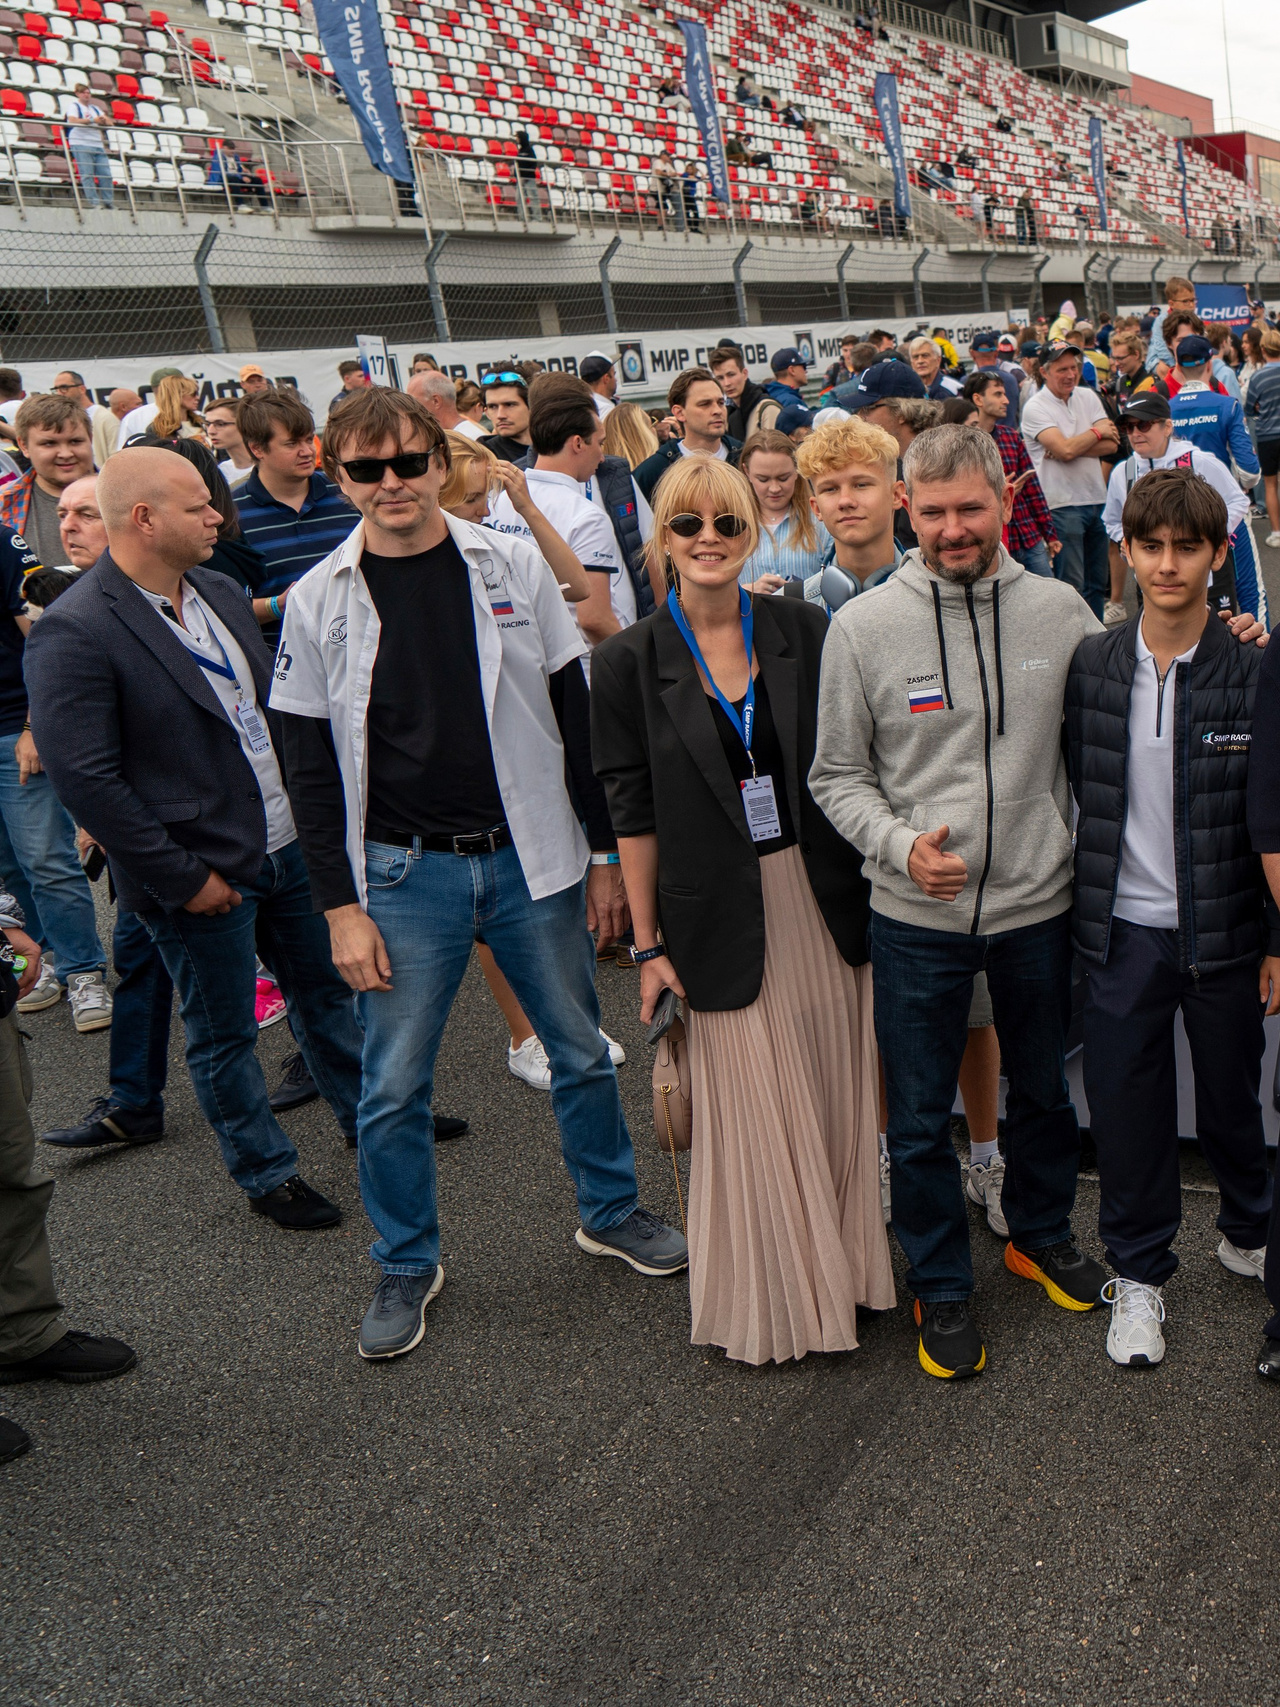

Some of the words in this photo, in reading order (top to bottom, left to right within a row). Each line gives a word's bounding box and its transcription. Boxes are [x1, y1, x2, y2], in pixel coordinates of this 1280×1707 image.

[1194, 305, 1250, 320] LCHUG
[370, 355, 385, 376] 17
[651, 349, 690, 373] МИР
[1180, 394, 1198, 402] HRX
[1172, 419, 1189, 428] SMP
[1188, 414, 1219, 426] RACING
[500, 524, 522, 534] SMP
[501, 619, 530, 629] RACING
[907, 673, 940, 685] ZASPORT
[1214, 734, 1230, 742] SMP
